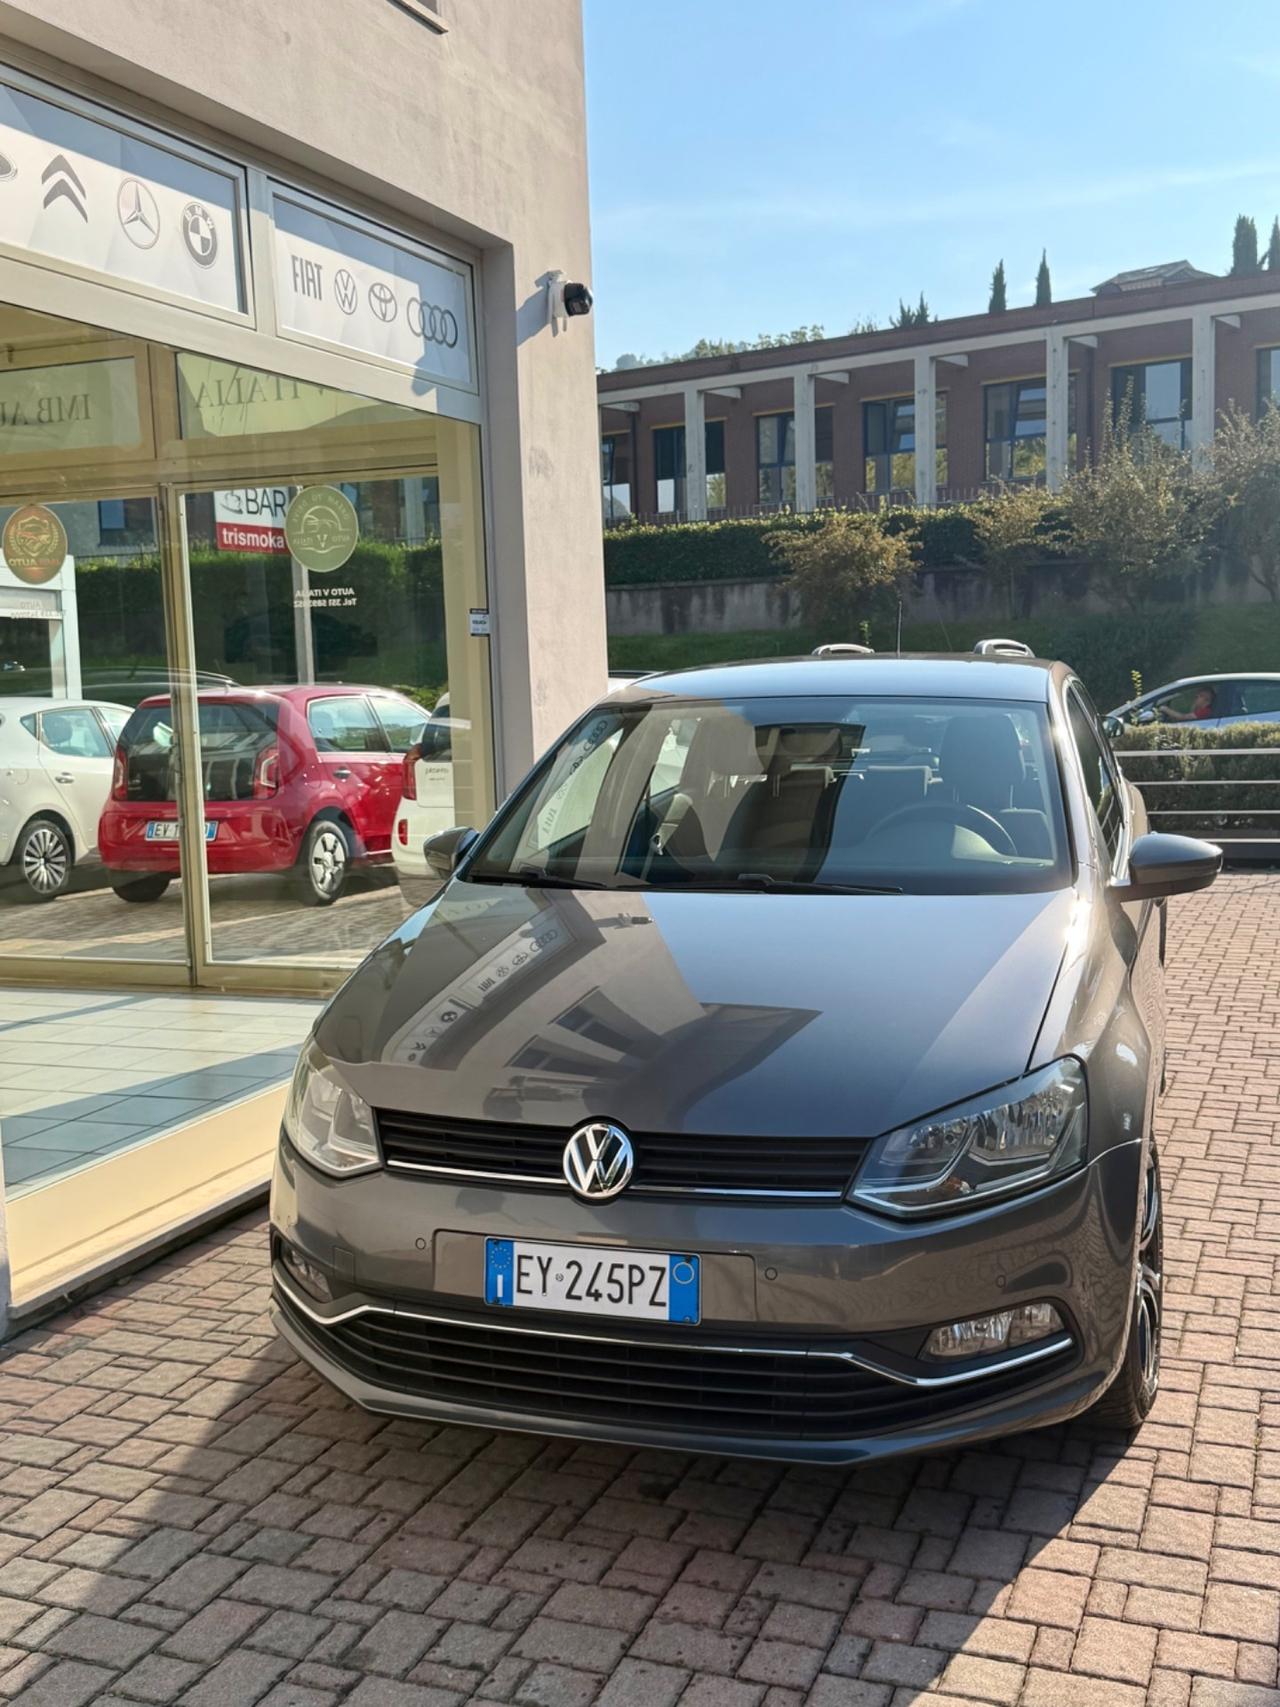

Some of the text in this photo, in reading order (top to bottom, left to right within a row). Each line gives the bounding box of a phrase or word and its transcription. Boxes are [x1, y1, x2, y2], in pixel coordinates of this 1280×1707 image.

[291, 254, 323, 301] FIAT
[245, 488, 287, 517] BAR
[222, 528, 285, 549] trismoka
[516, 1254, 667, 1307] EY 245PZ
